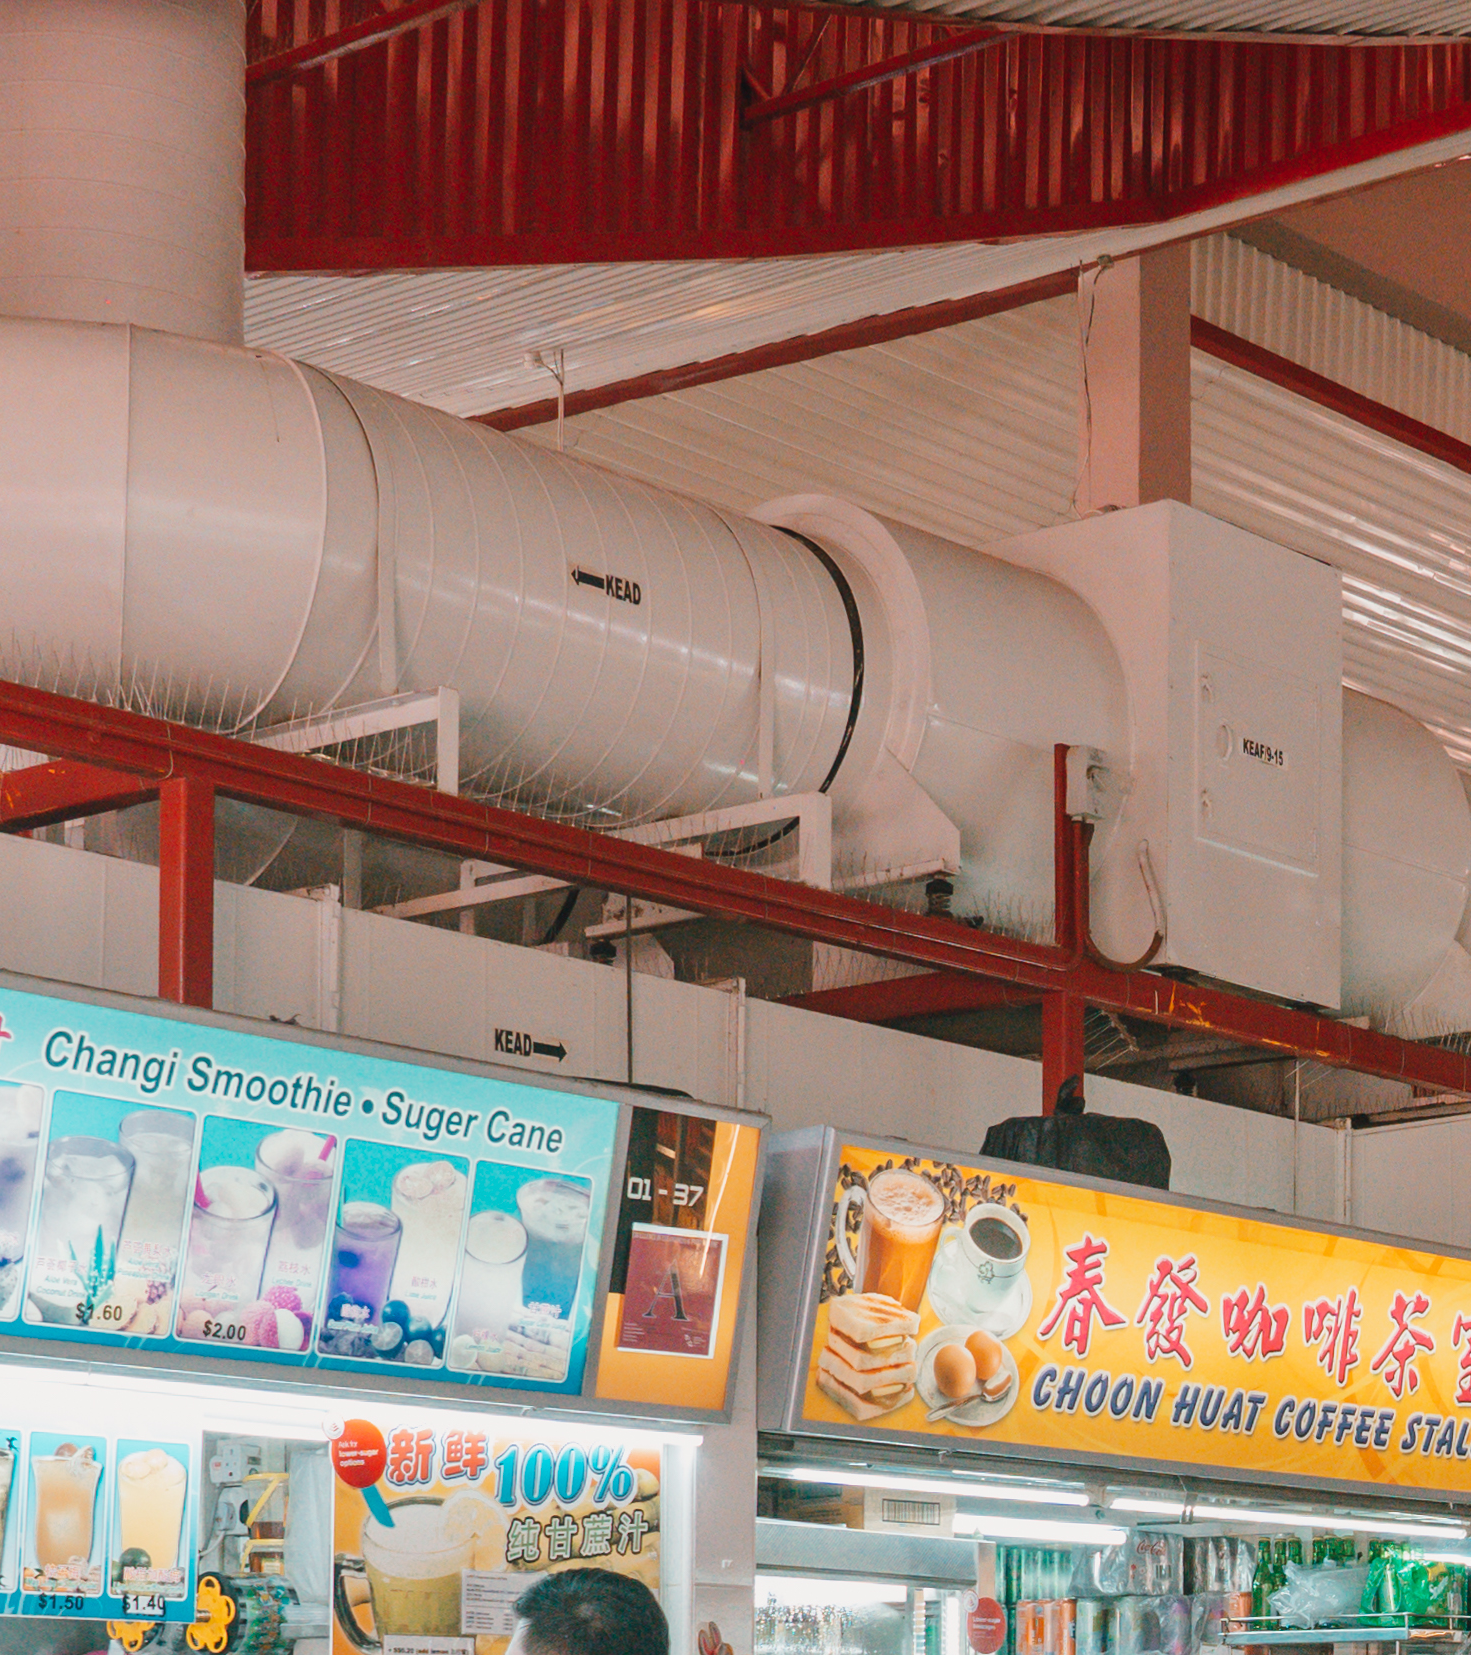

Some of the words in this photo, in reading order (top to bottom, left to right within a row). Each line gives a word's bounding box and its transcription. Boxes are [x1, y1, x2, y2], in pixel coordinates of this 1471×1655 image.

[606, 574, 641, 605] KEAD
[1242, 738, 1284, 766] KEAF/9-15
[494, 1028, 531, 1057] KEAD
[44, 1030, 179, 1090] Changi
[186, 1055, 352, 1118] Smoothie
[381, 1091, 479, 1142] Suger
[486, 1110, 565, 1153] Cane
[641, 1258, 691, 1322] A
[75, 1302, 122, 1321] $1.60
[202, 1320, 247, 1341] $2.00
[1032, 1364, 1164, 1422] CHOON
[1170, 1381, 1268, 1436] HUAT
[1274, 1397, 1395, 1451] COFFEE
[339, 1458, 365, 1467] options
[386, 1425, 489, 1486] 新鲜
[495, 1442, 634, 1508] 100%
[506, 1510, 648, 1562] 纯甘蔗汁
[38, 1592, 84, 1610] $1.50
[122, 1595, 166, 1611] $1.40
